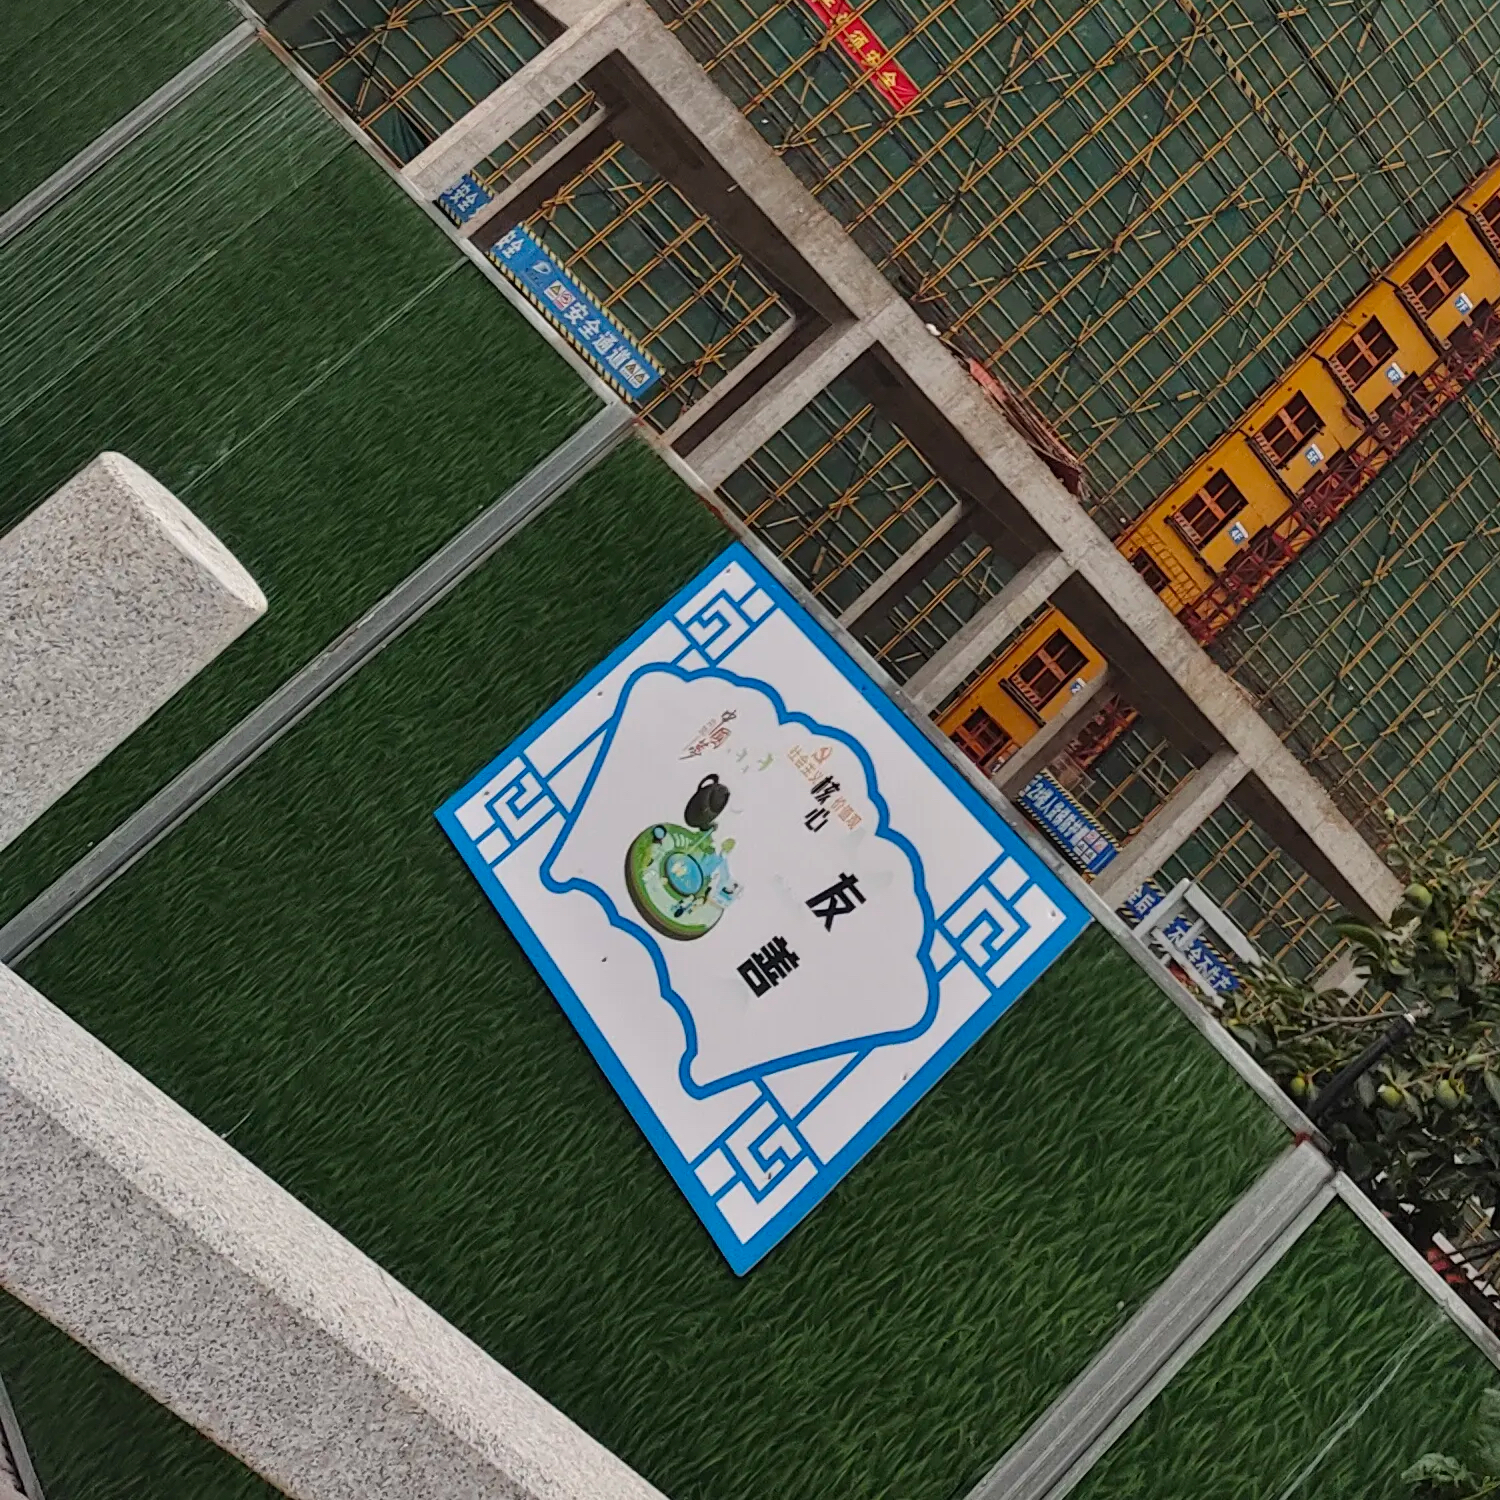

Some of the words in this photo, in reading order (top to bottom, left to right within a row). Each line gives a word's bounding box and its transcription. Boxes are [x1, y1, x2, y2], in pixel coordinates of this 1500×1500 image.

[1454, 298, 1468, 313] 7F
[564, 301, 632, 368] 安全通道
[1386, 368, 1400, 384] 6F
[1304, 448, 1320, 466] 5F
[1229, 527, 1244, 543] 4F
[736, 872, 866, 998] 友善
